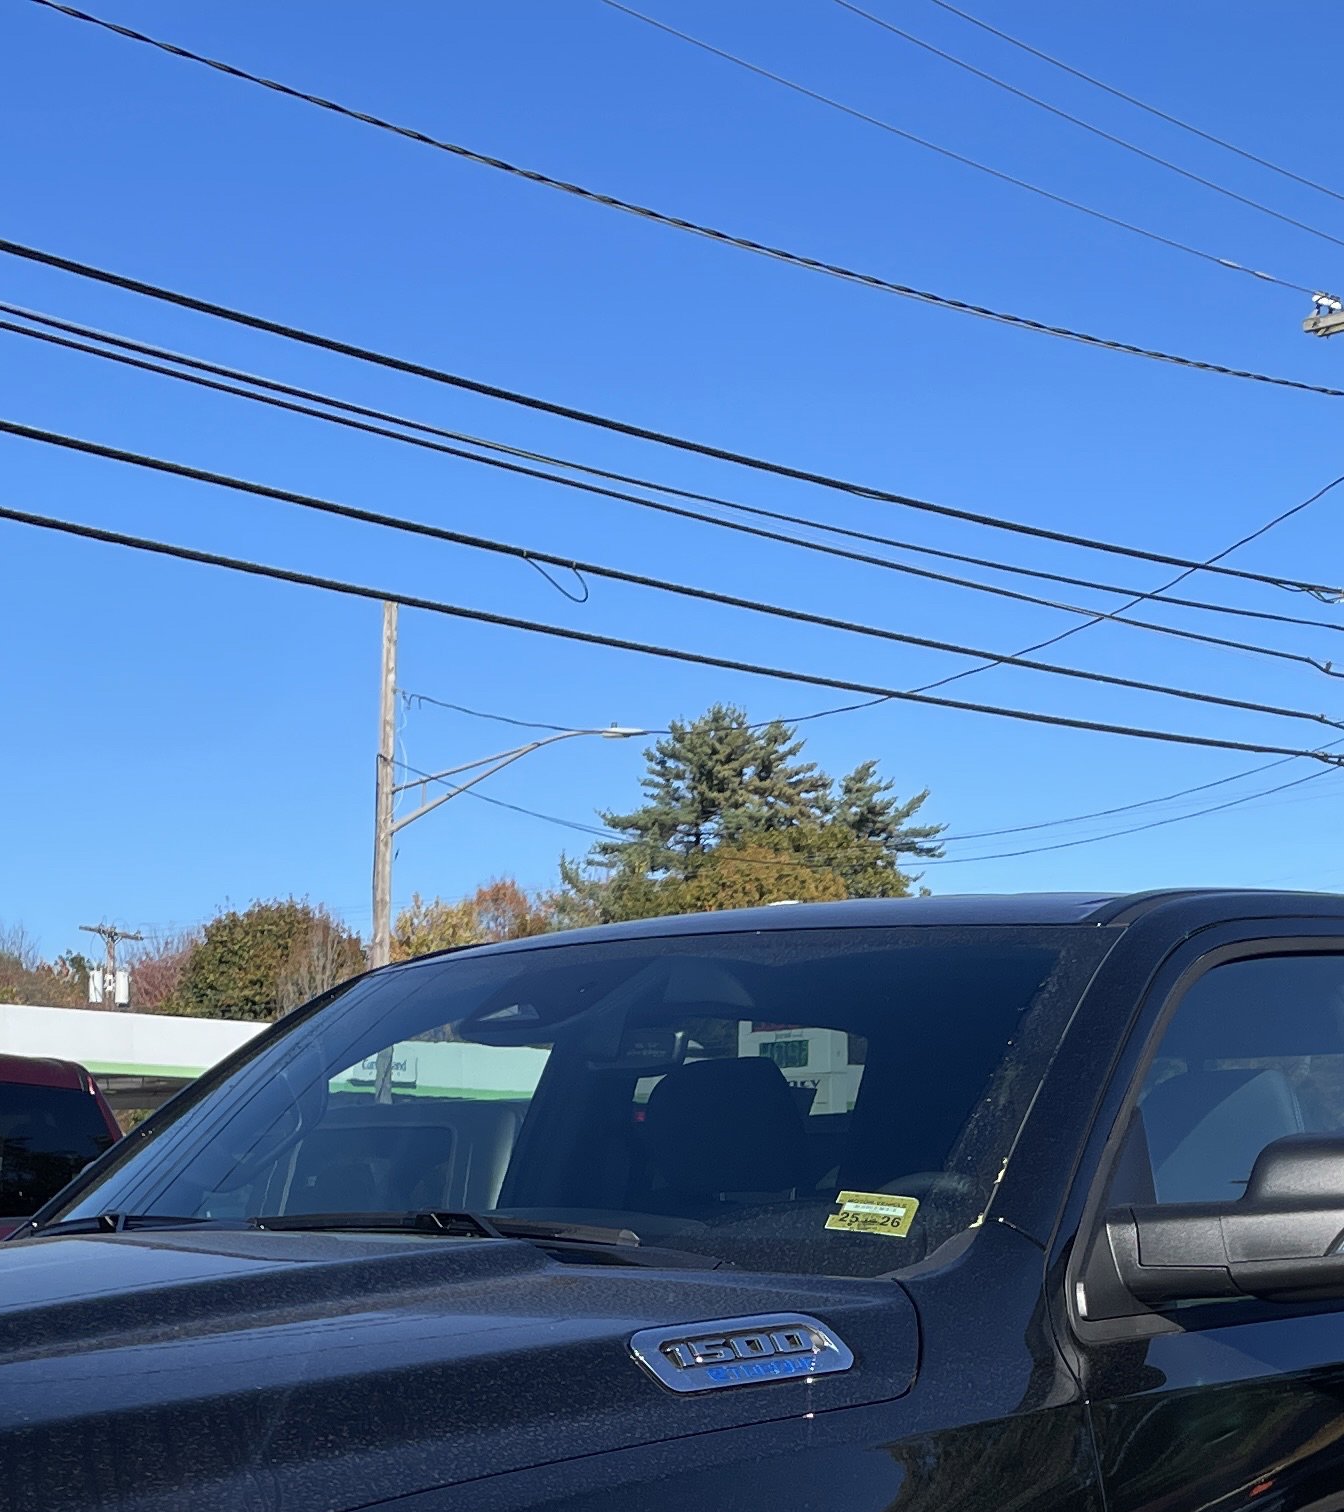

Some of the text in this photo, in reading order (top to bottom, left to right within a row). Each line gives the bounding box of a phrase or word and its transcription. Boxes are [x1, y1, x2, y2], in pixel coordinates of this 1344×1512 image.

[839, 1212, 859, 1223] 25
[879, 1215, 902, 1228] 26
[666, 1328, 815, 1369] 1500
